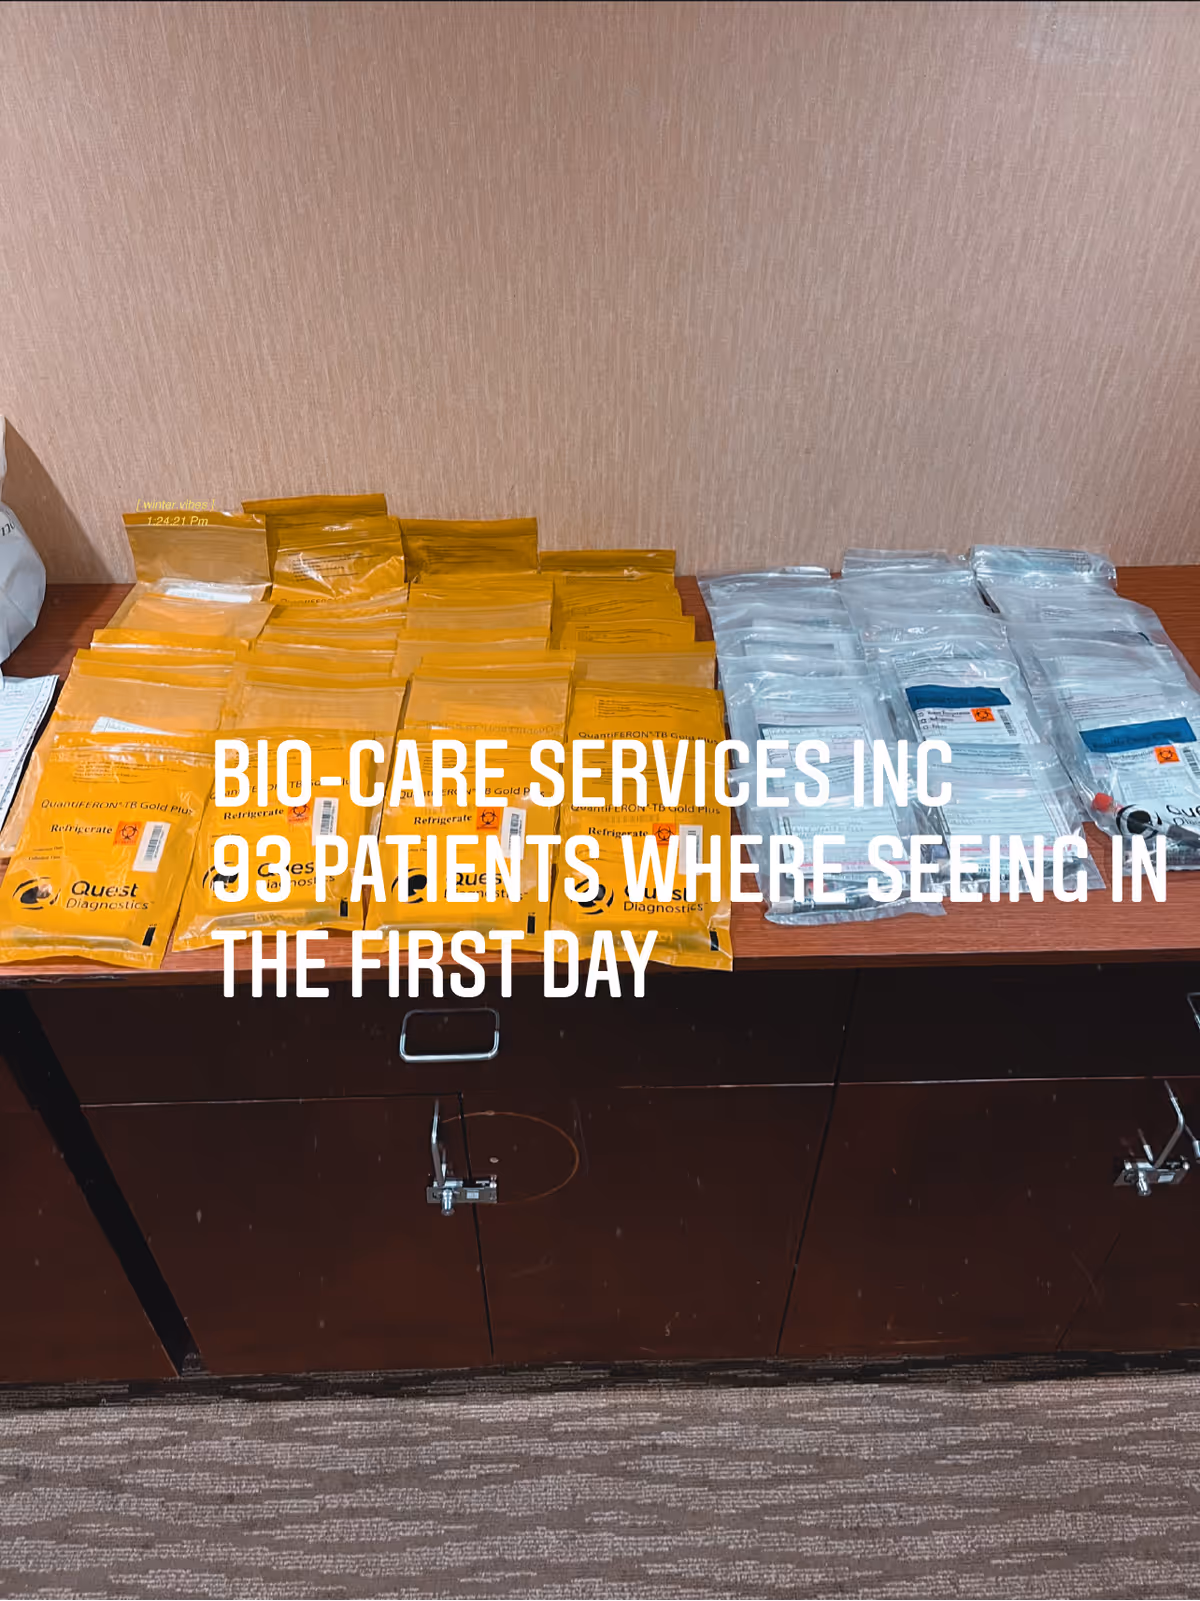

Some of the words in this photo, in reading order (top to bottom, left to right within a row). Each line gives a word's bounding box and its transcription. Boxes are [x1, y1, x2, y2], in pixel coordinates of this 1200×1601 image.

[494, 787, 521, 796] Gold
[140, 801, 168, 812] Gold
[223, 808, 285, 820] Refrigerate
[413, 814, 473, 826] Refrigerate
[50, 824, 113, 836] Refrigerate
[588, 827, 649, 838] Refrigerate
[71, 880, 139, 898] Quest
[66, 898, 149, 912] Diagnostics
[623, 901, 704, 915] Diagnostics
